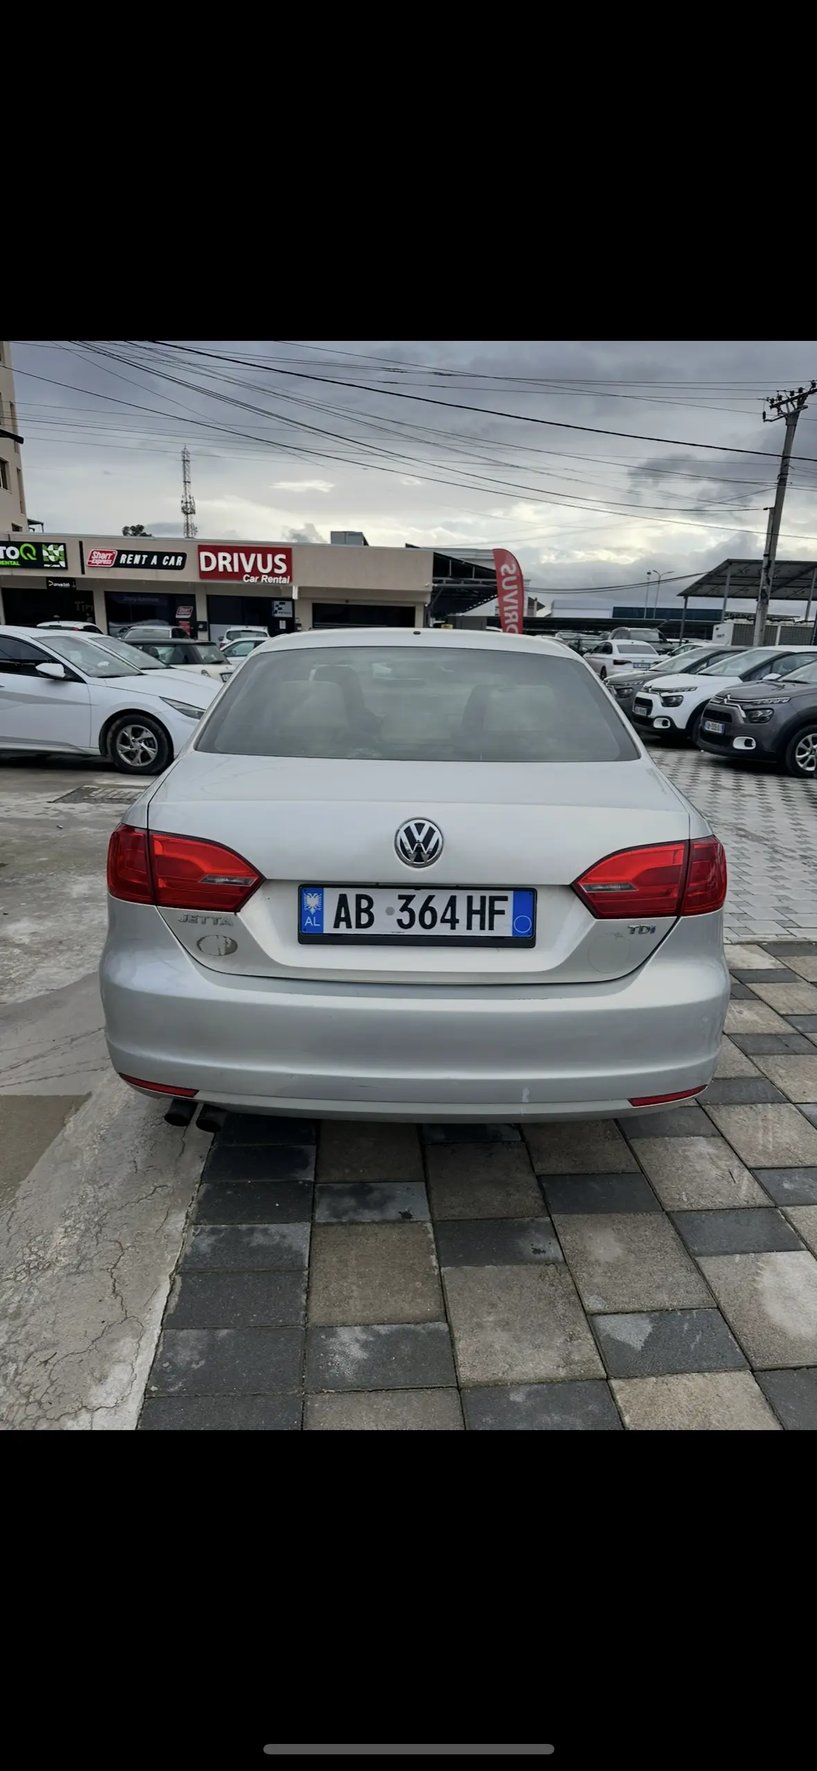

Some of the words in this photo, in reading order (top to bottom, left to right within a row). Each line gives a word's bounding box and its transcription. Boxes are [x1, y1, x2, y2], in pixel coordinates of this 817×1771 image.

[120, 554, 148, 565] RENT
[151, 555, 157, 566] A
[162, 556, 183, 566] CAR
[199, 551, 287, 574] DRIVUS
[243, 574, 259, 583] Car
[261, 575, 290, 584] Rental
[333, 893, 375, 929] AB
[178, 914, 234, 926] JETTA
[304, 916, 321, 927] AL
[627, 924, 656, 935] TDI
